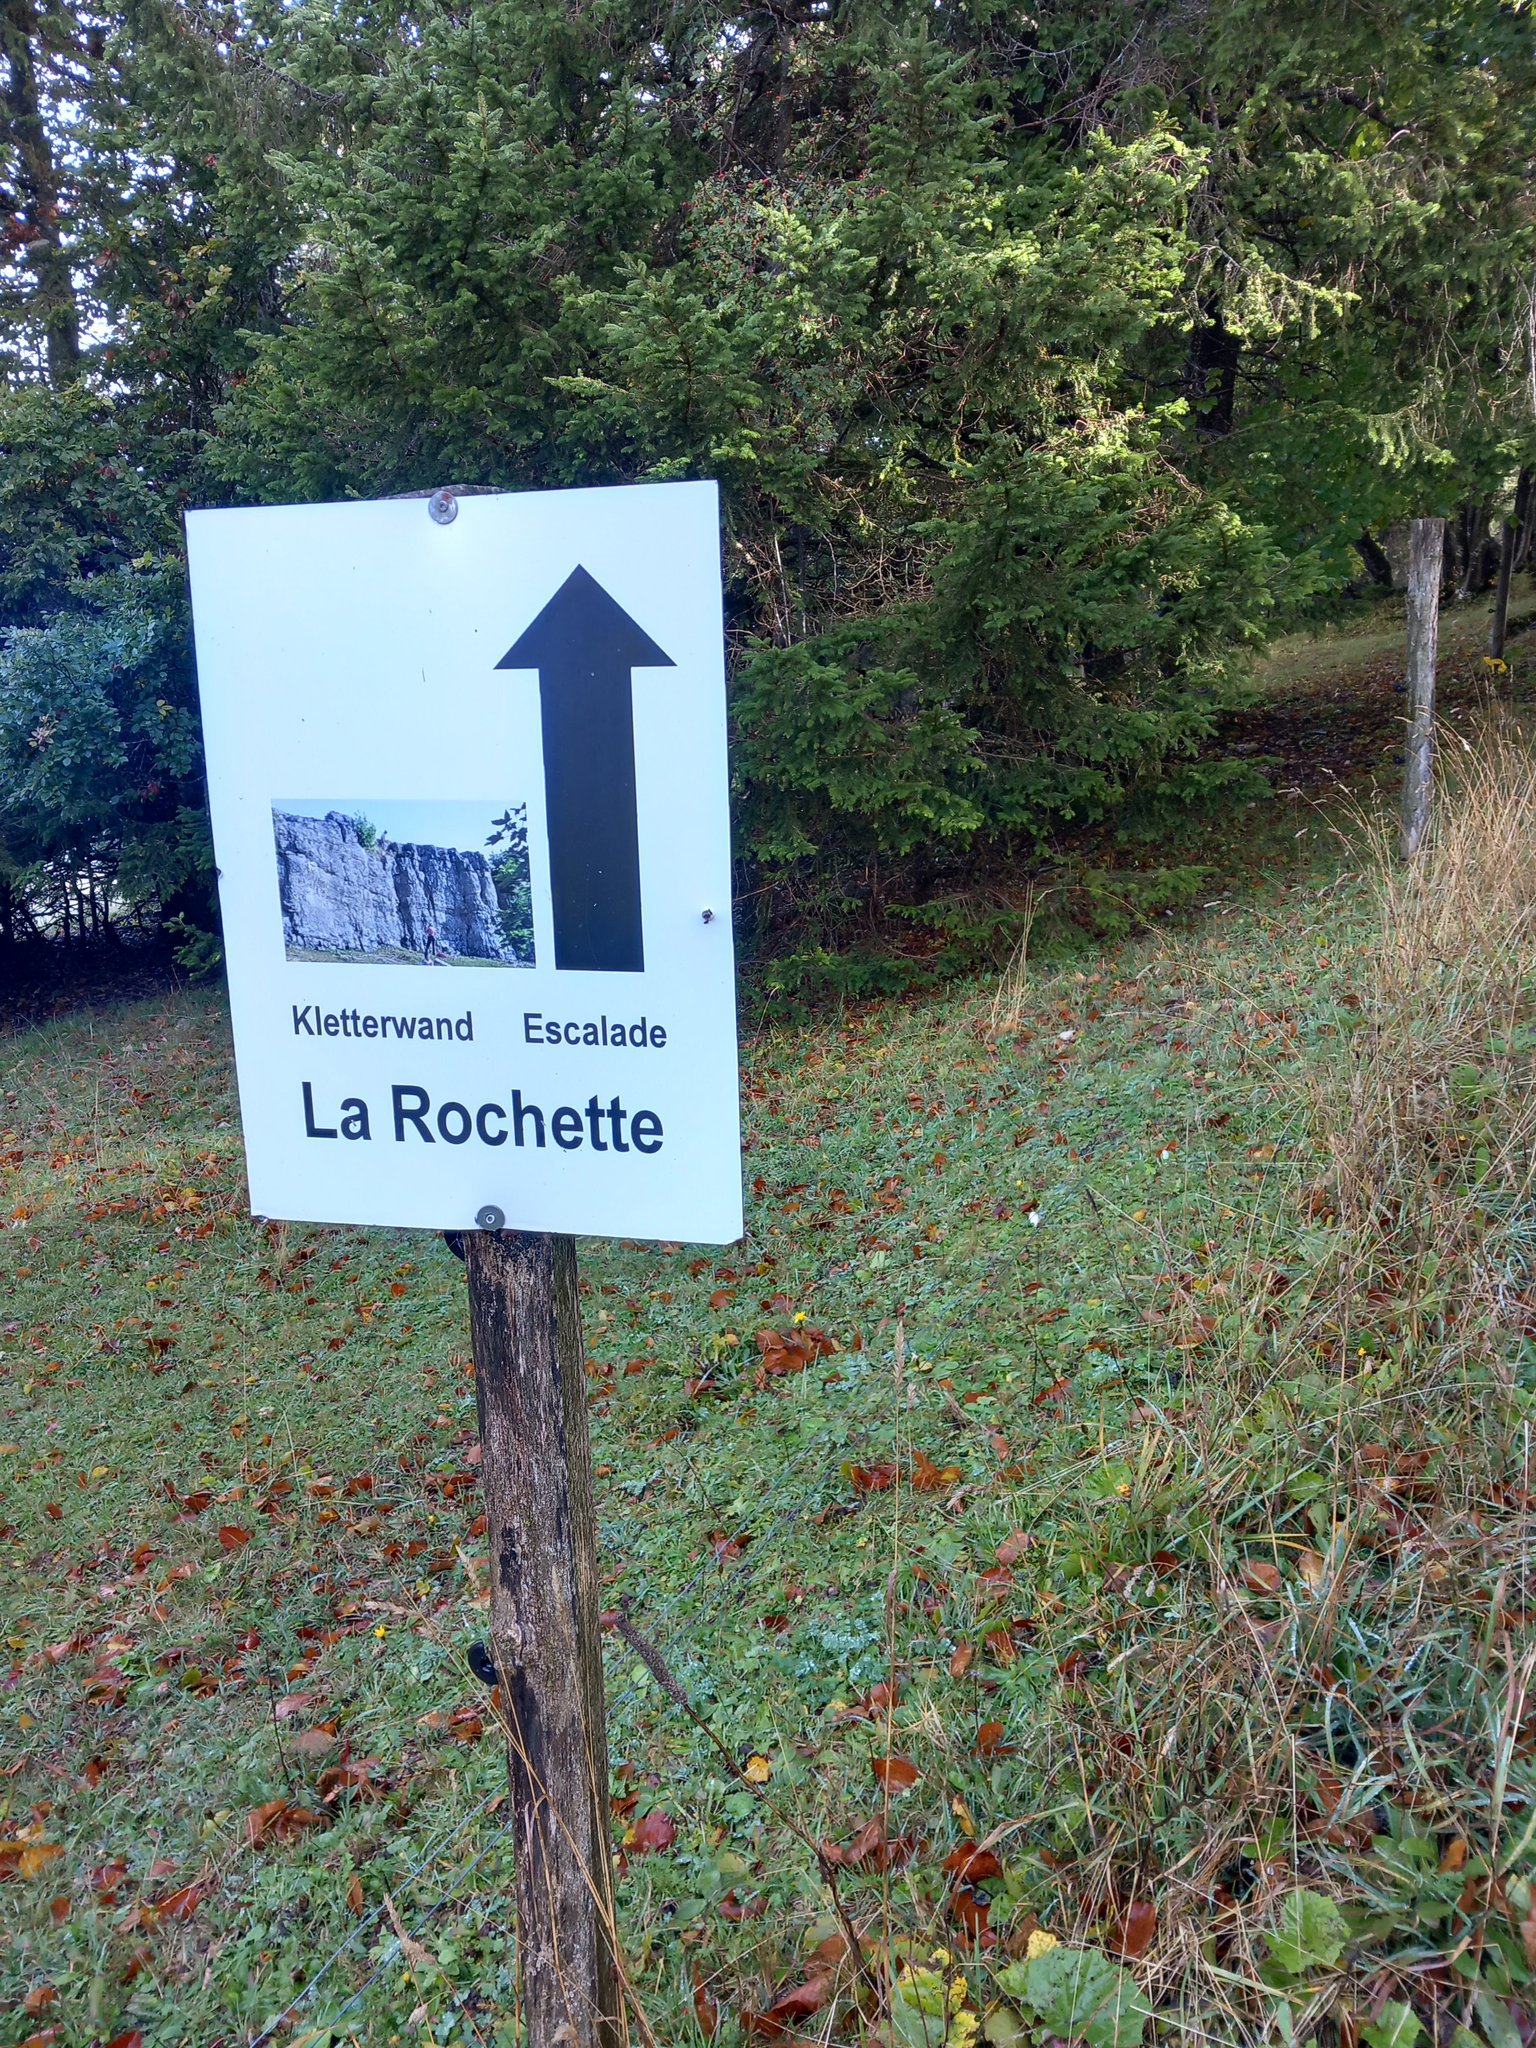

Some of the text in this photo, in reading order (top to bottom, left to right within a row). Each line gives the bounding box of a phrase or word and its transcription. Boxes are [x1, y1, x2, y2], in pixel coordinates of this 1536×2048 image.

[292, 1005, 668, 1049] Kletterwand Escalade
[301, 1081, 664, 1154] La Rochette
